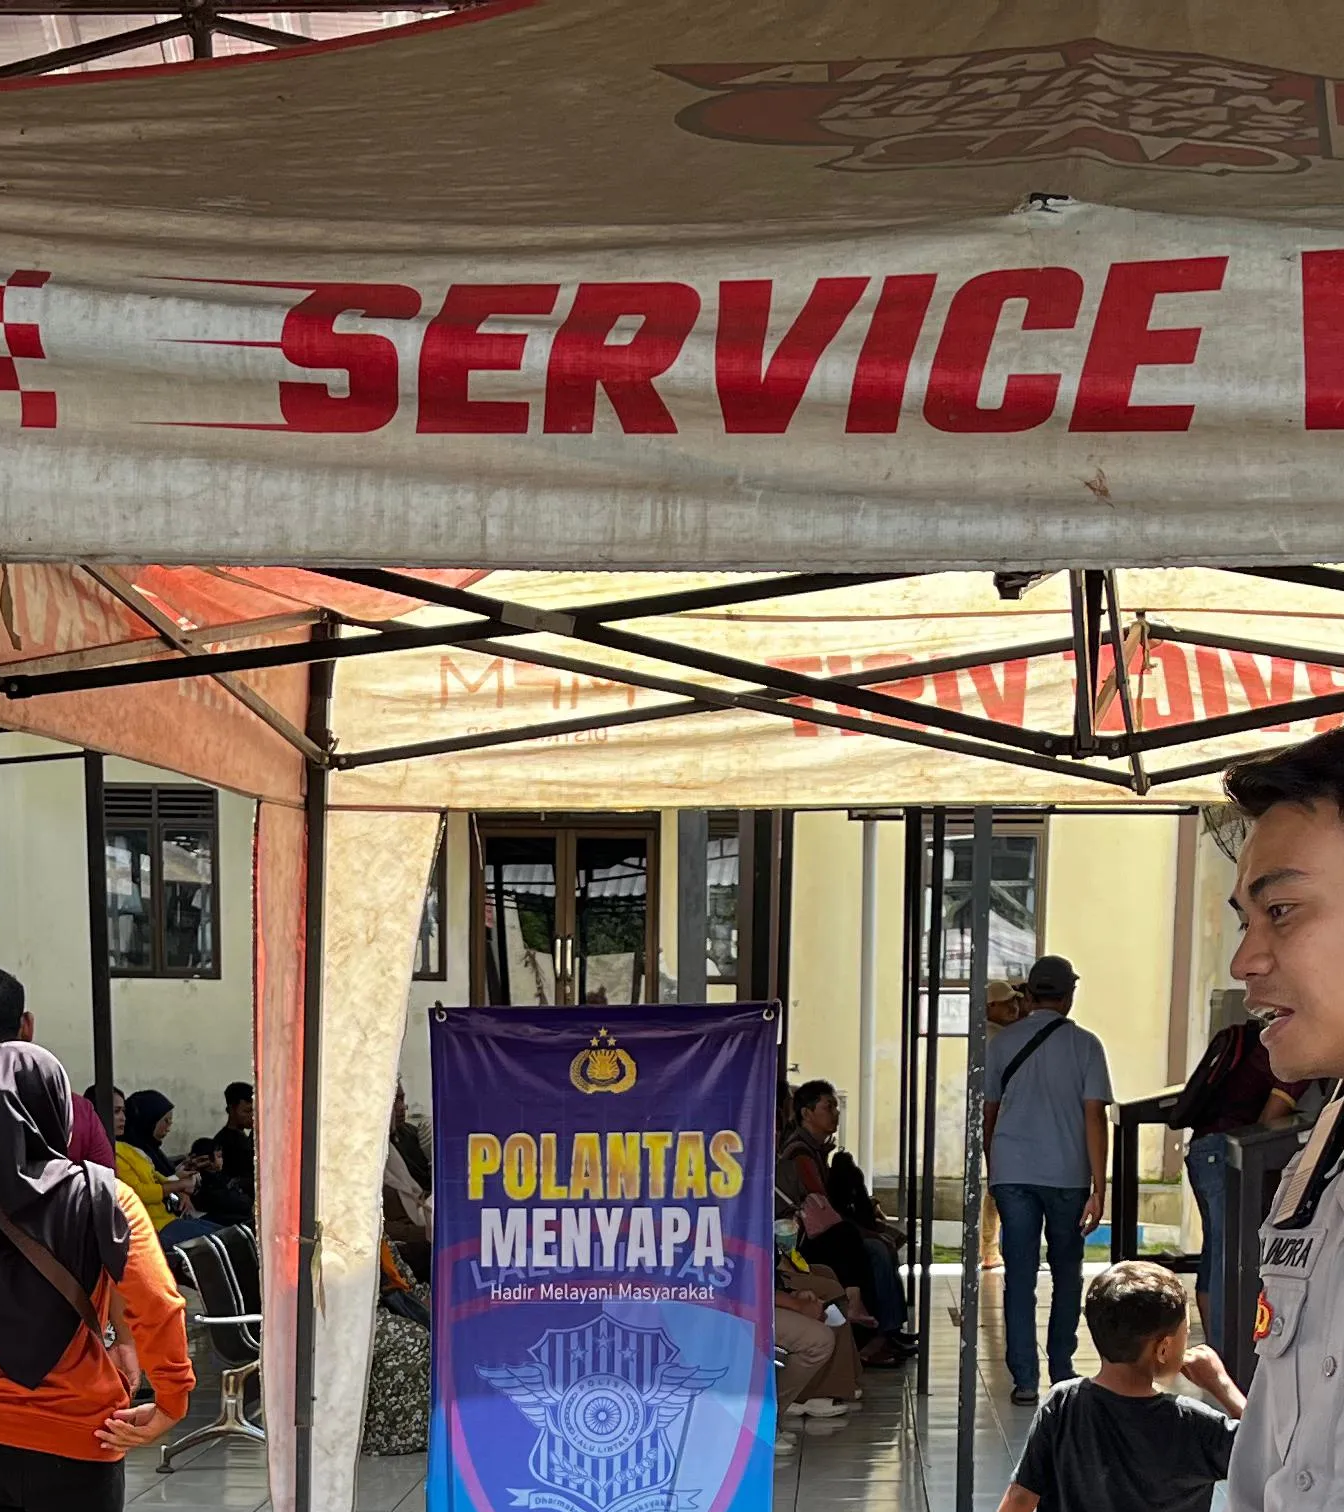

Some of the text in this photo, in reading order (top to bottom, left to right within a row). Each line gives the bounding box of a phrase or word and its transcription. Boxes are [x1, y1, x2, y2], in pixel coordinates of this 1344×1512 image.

[278, 255, 1231, 434] SERVICE
[467, 1129, 744, 1201] POLANTAS
[479, 1206, 726, 1268] MENYAPA
[490, 1282, 715, 1305] Hadir Melayani Masyarakat
